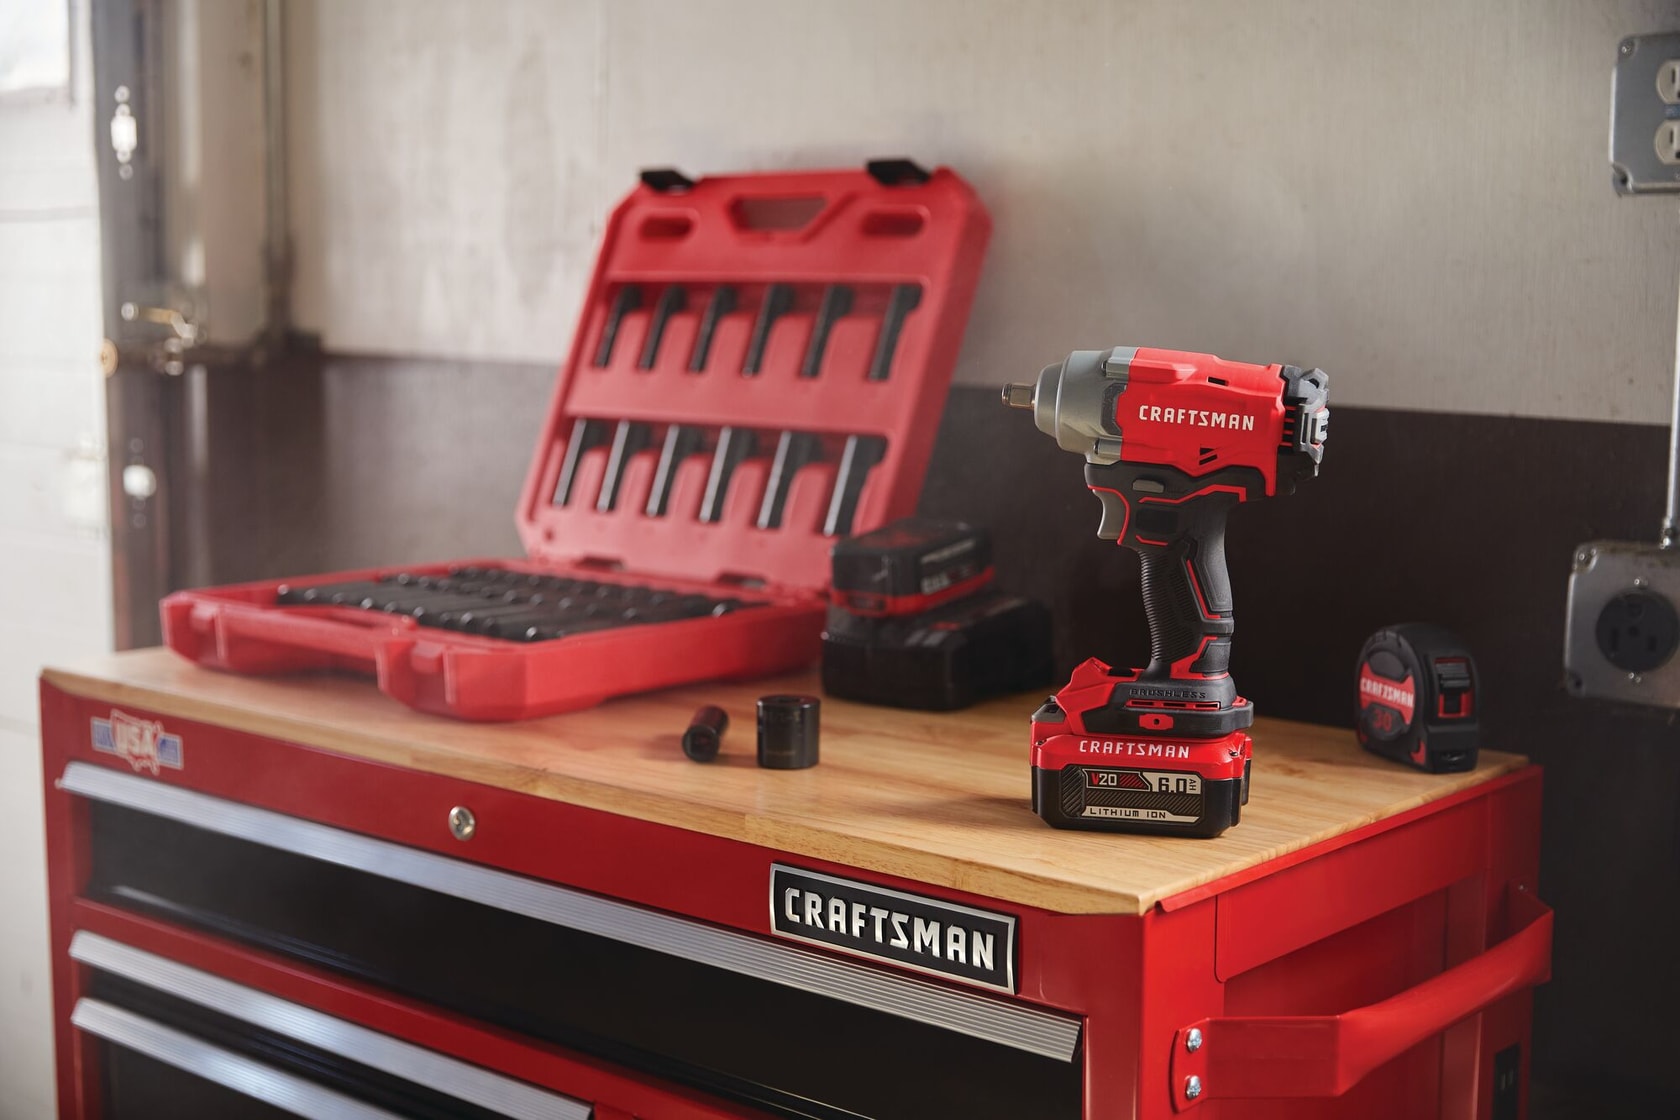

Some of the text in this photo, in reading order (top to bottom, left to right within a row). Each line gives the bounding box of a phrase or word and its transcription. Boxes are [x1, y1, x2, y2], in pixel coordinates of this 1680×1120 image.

[1138, 404, 1255, 432] CRAFTSMAN
[1129, 687, 1207, 700] BRUSHLESS
[1079, 739, 1189, 758] CRAFTSMAN
[1091, 772, 1118, 787] V20
[1090, 807, 1167, 819] LITHIUM ION
[785, 886, 995, 972] CRAFTSMAN
